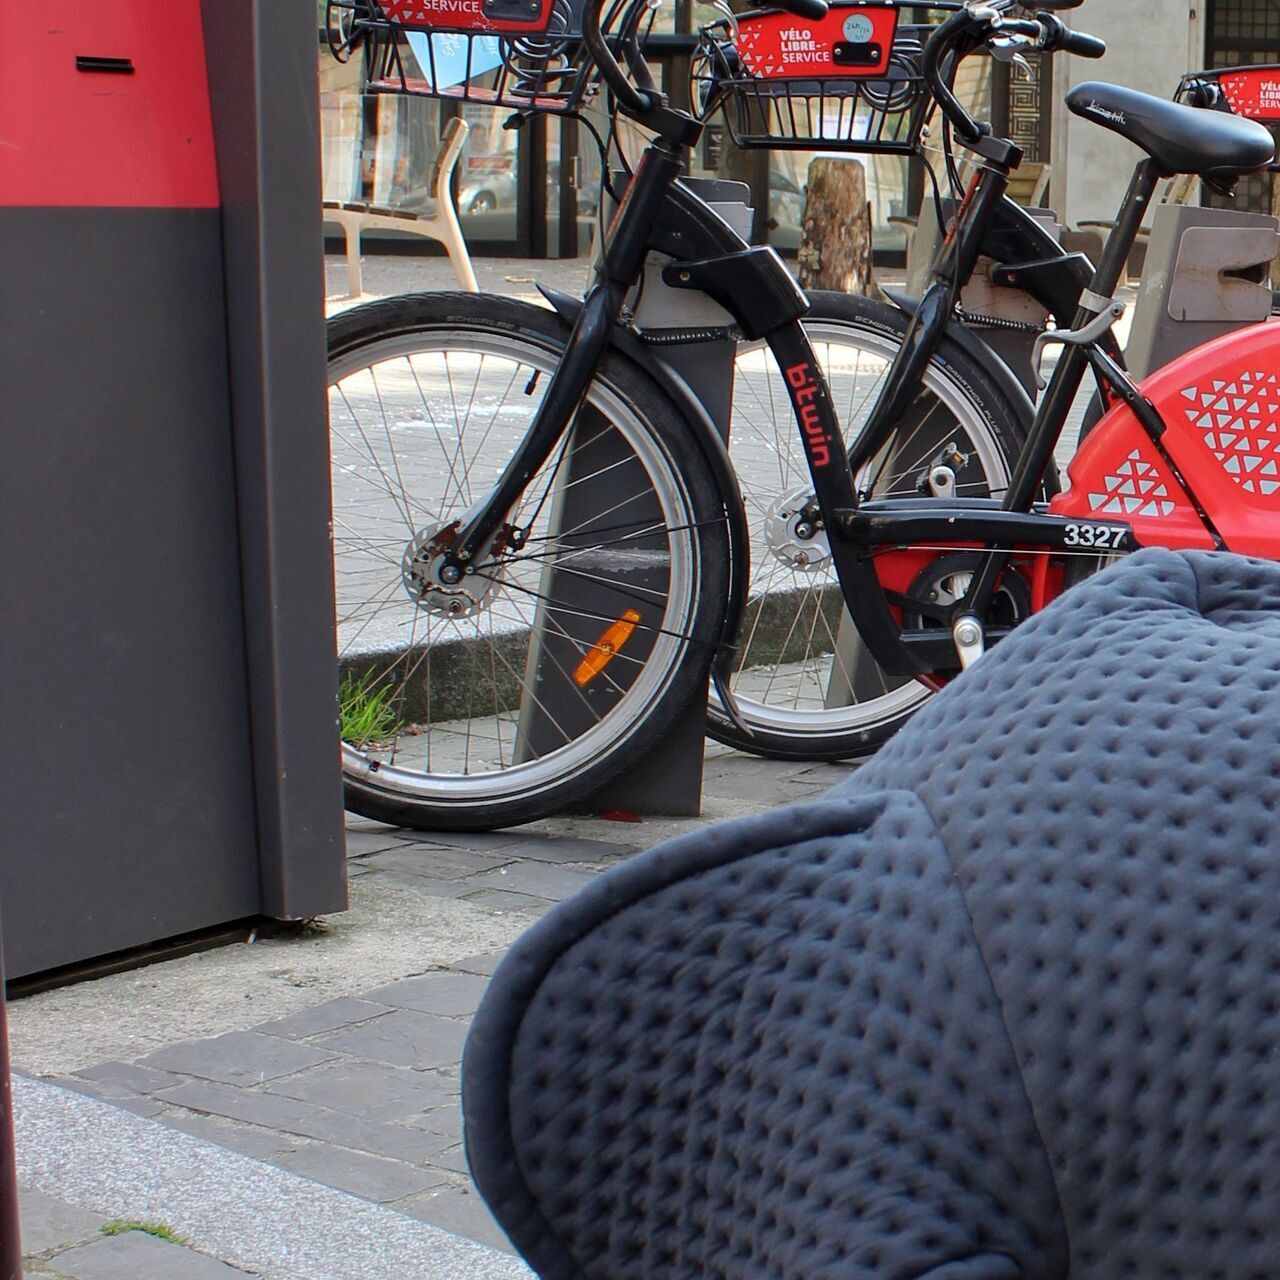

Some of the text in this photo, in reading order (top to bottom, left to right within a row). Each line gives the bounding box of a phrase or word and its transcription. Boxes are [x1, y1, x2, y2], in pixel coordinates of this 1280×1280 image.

[423, 0, 480, 13] SERVICE
[779, 27, 811, 41] VÉLO
[781, 40, 821, 52] LIBRE-
[782, 52, 830, 63] SERVICE
[854, 315, 905, 338] SCHWALB
[1063, 523, 1128, 548] 3327
